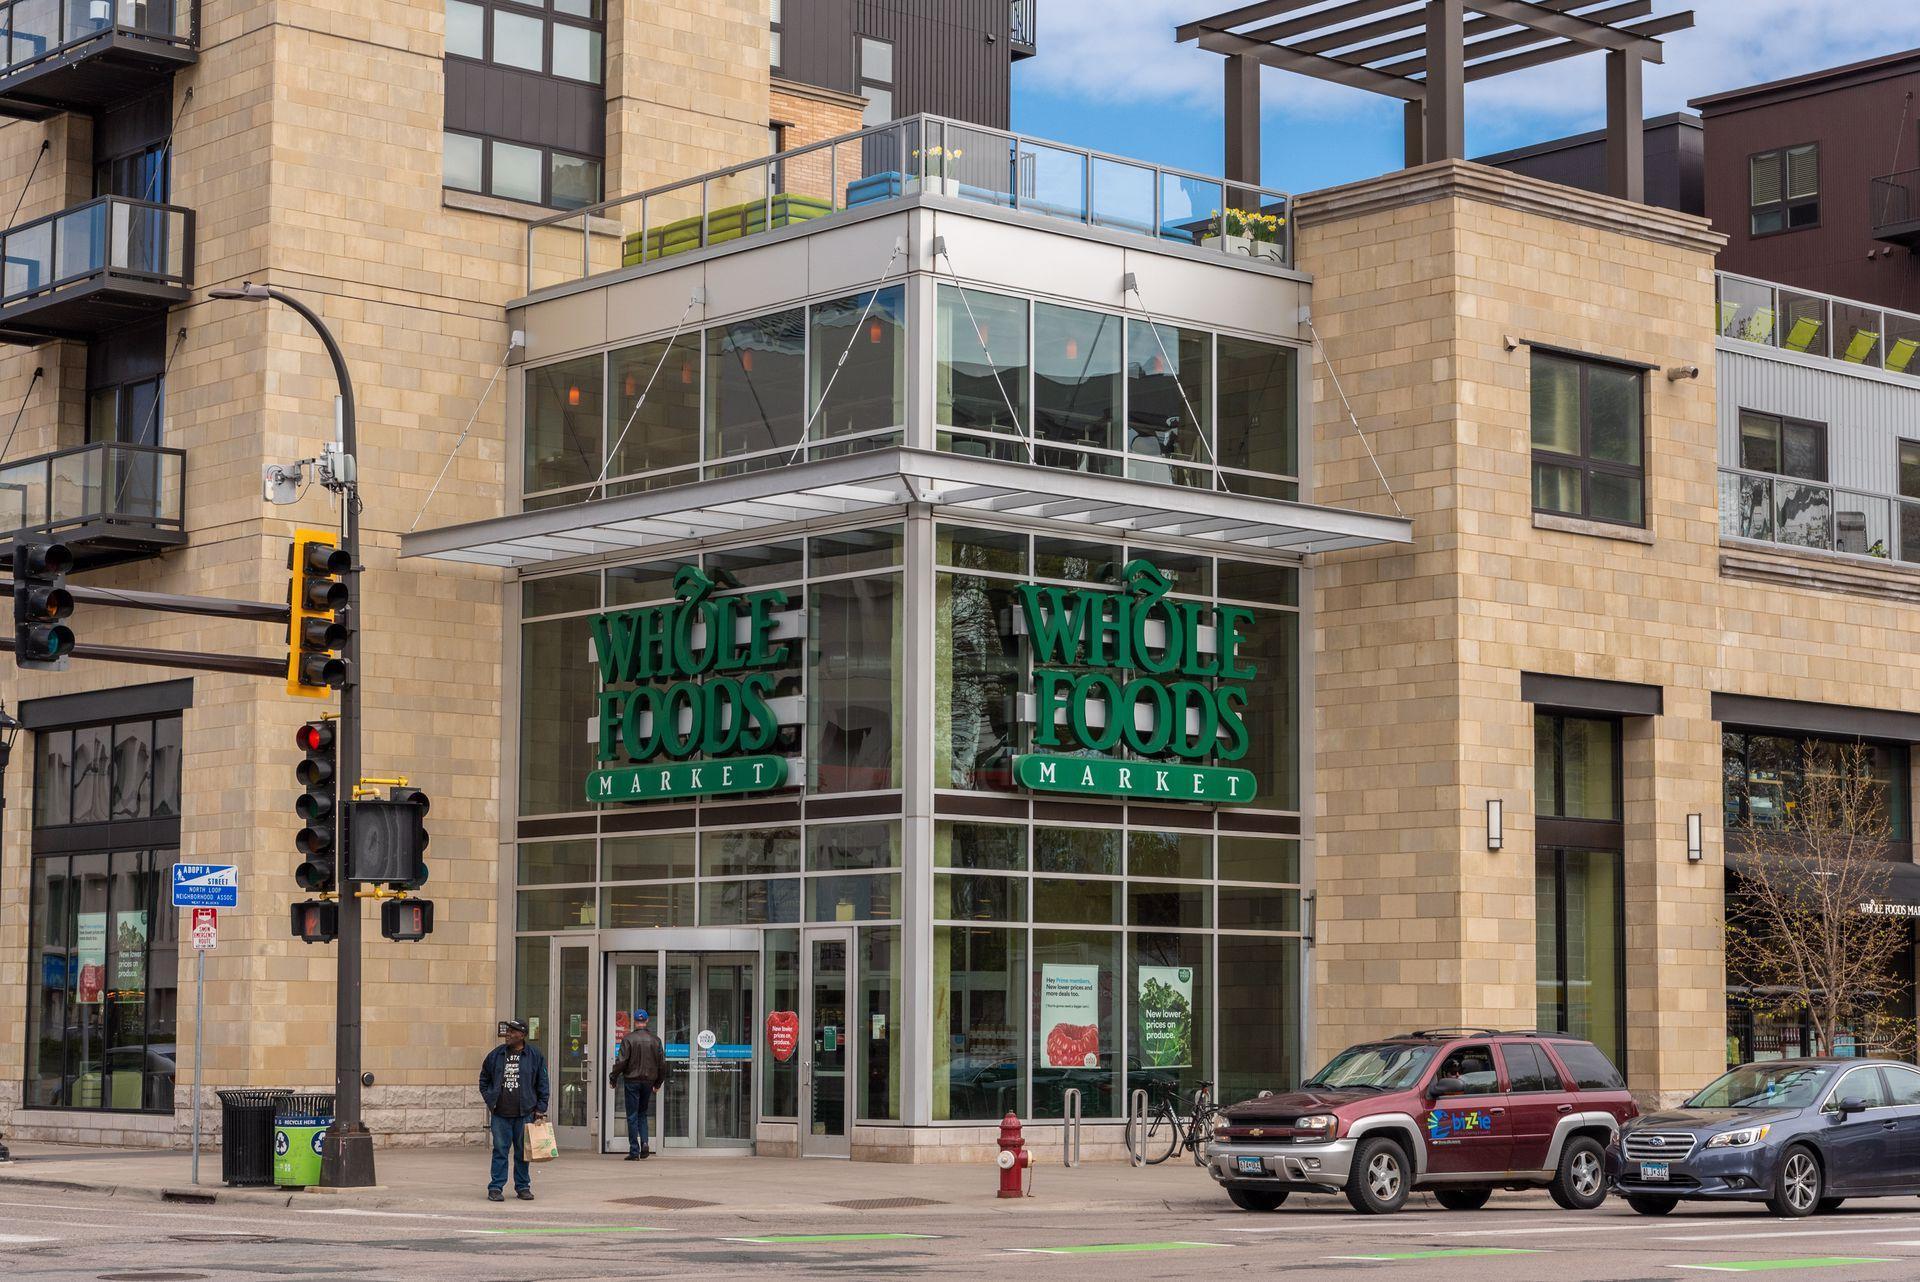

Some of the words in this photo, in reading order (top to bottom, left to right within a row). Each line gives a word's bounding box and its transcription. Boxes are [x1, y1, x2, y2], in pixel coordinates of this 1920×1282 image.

[587, 588, 789, 684] WHOLE
[1015, 582, 1257, 680] WHOLE
[596, 673, 778, 761] FOODS
[1031, 668, 1249, 761] FOODS
[599, 763, 764, 796] MARKET
[1039, 762, 1240, 796] MARKET
[183, 866, 203, 874] ADOPT
[205, 866, 210, 874] A
[1860, 899, 1884, 914] WHOLE
[1885, 904, 1906, 915] FOODS
[1145, 1009, 1162, 1018] New
[1162, 1009, 1181, 1018] lower
[1146, 1020, 1166, 1030] prices
[1146, 1031, 1176, 1041] produce.
[1451, 1110, 1491, 1131] bizzie
